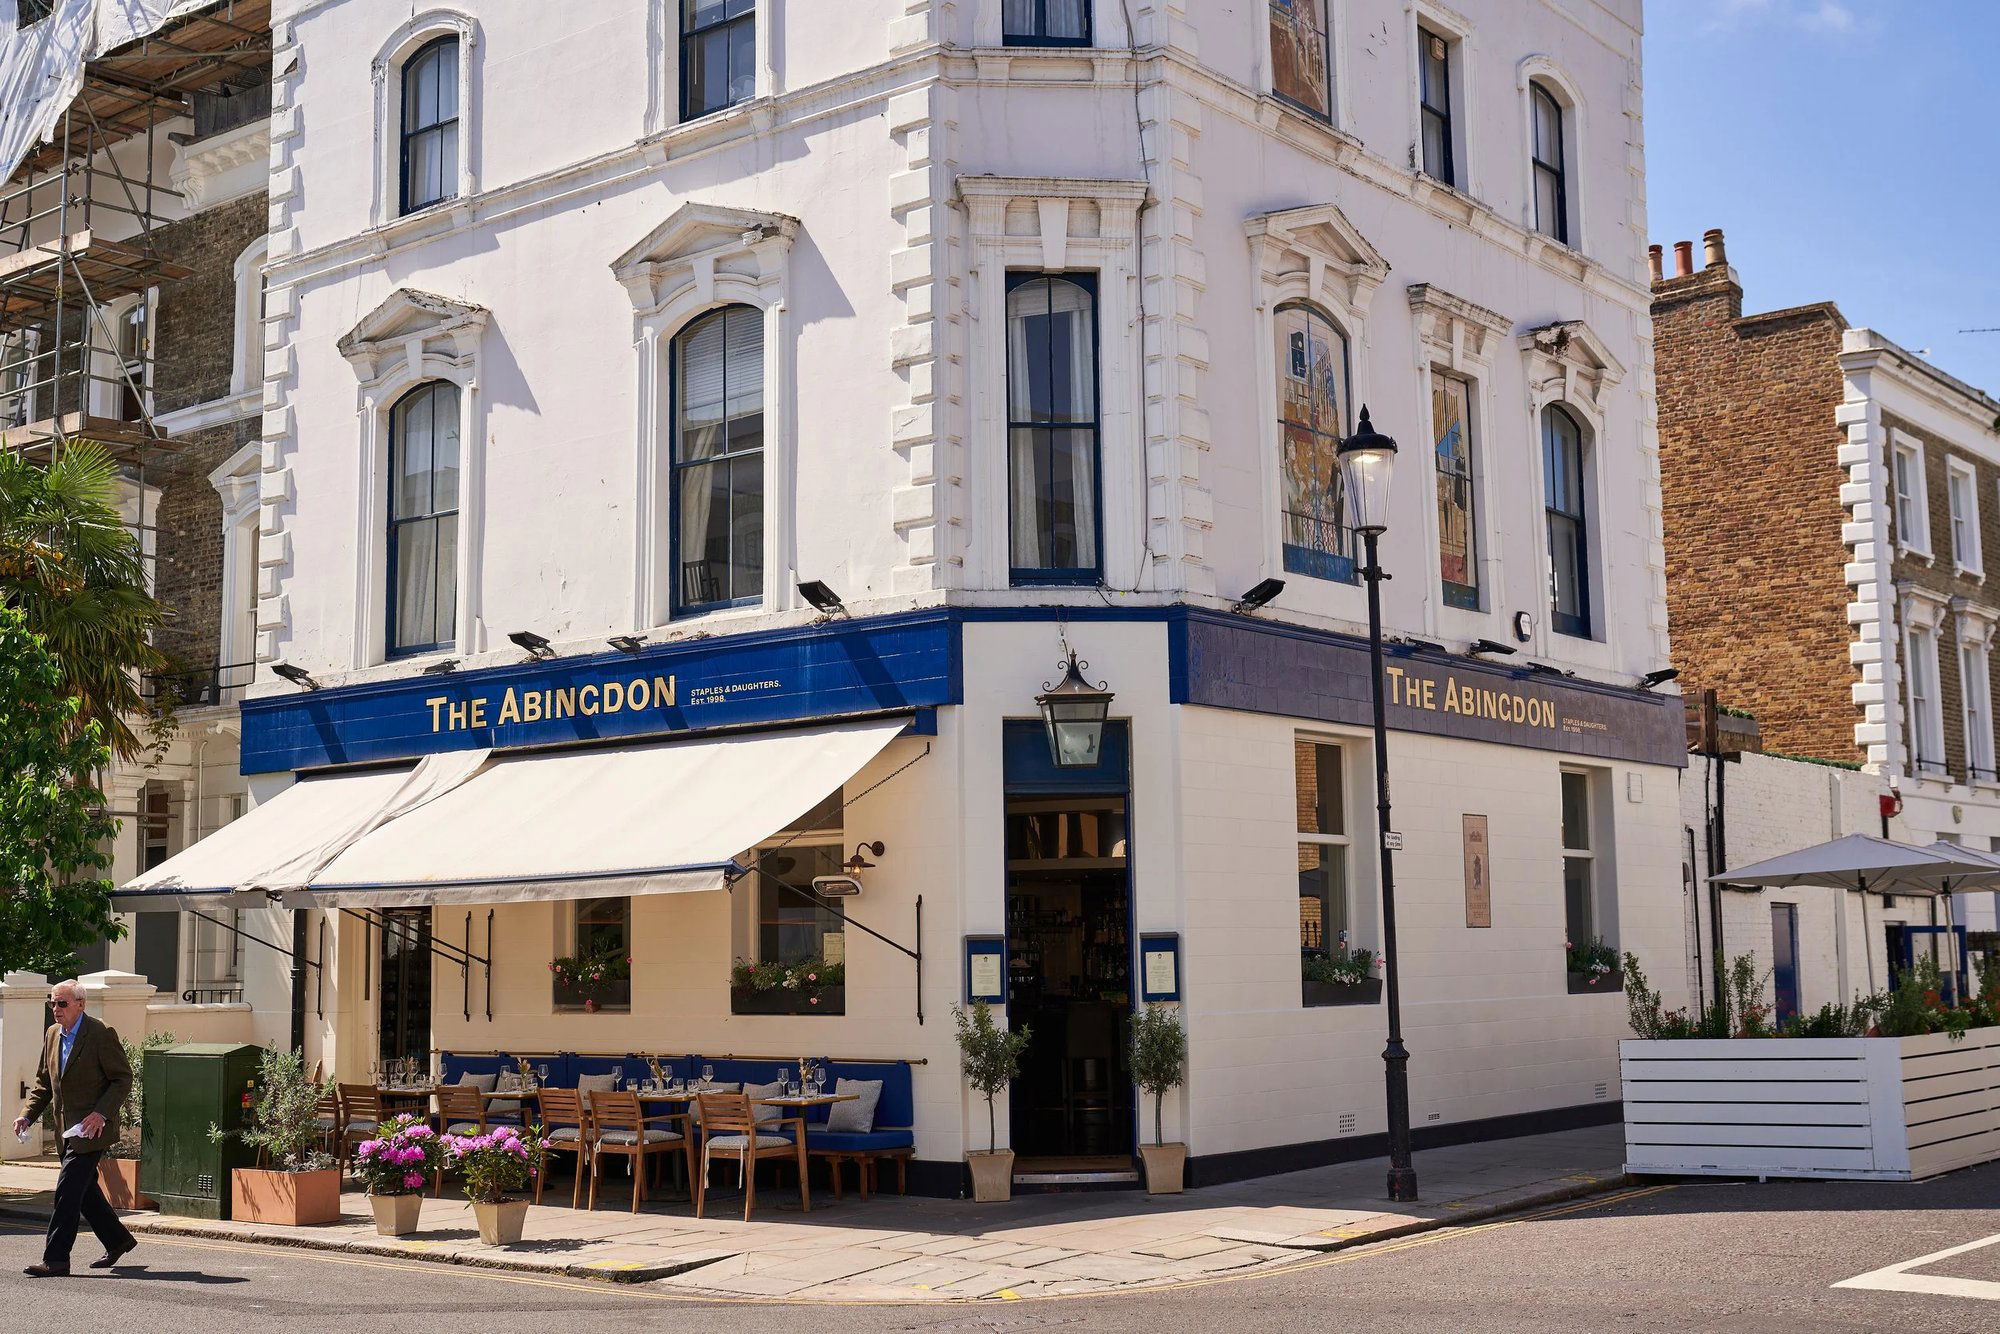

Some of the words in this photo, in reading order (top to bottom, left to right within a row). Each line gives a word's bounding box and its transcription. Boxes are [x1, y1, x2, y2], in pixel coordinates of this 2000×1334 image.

[426, 696, 488, 732] THE
[497, 675, 677, 726] ABINGDON
[690, 686, 723, 697] STAPLES
[724, 685, 731, 693] &
[731, 680, 782, 692] DAUGHTERS.
[1386, 666, 1436, 710] THE
[1444, 677, 1556, 729] ABINGDON
